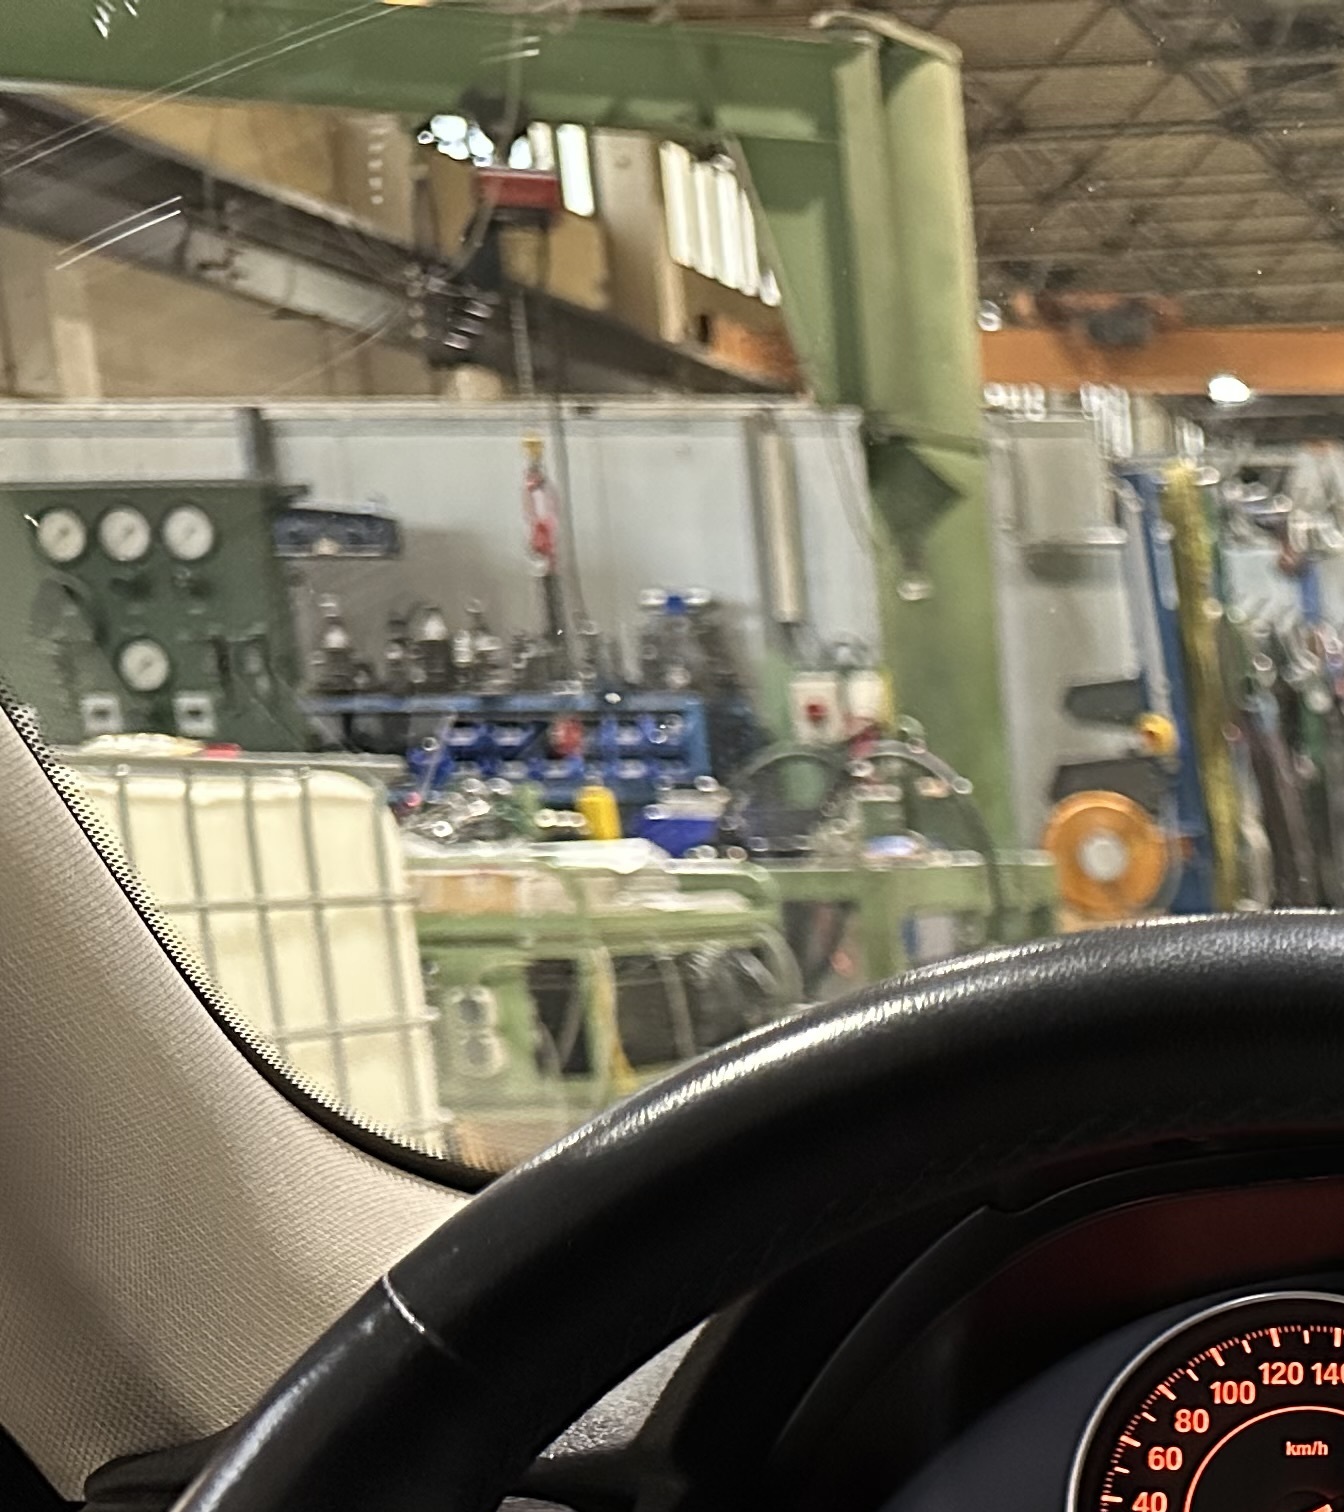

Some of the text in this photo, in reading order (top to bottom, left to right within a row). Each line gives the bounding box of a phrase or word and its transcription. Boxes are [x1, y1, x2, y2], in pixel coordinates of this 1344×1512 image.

[1259, 1363, 1304, 1385] 120
[1210, 1381, 1256, 1404] 100
[1175, 1410, 1209, 1433] 80
[1148, 1447, 1182, 1471] 60
[1285, 1441, 1329, 1457] km/h
